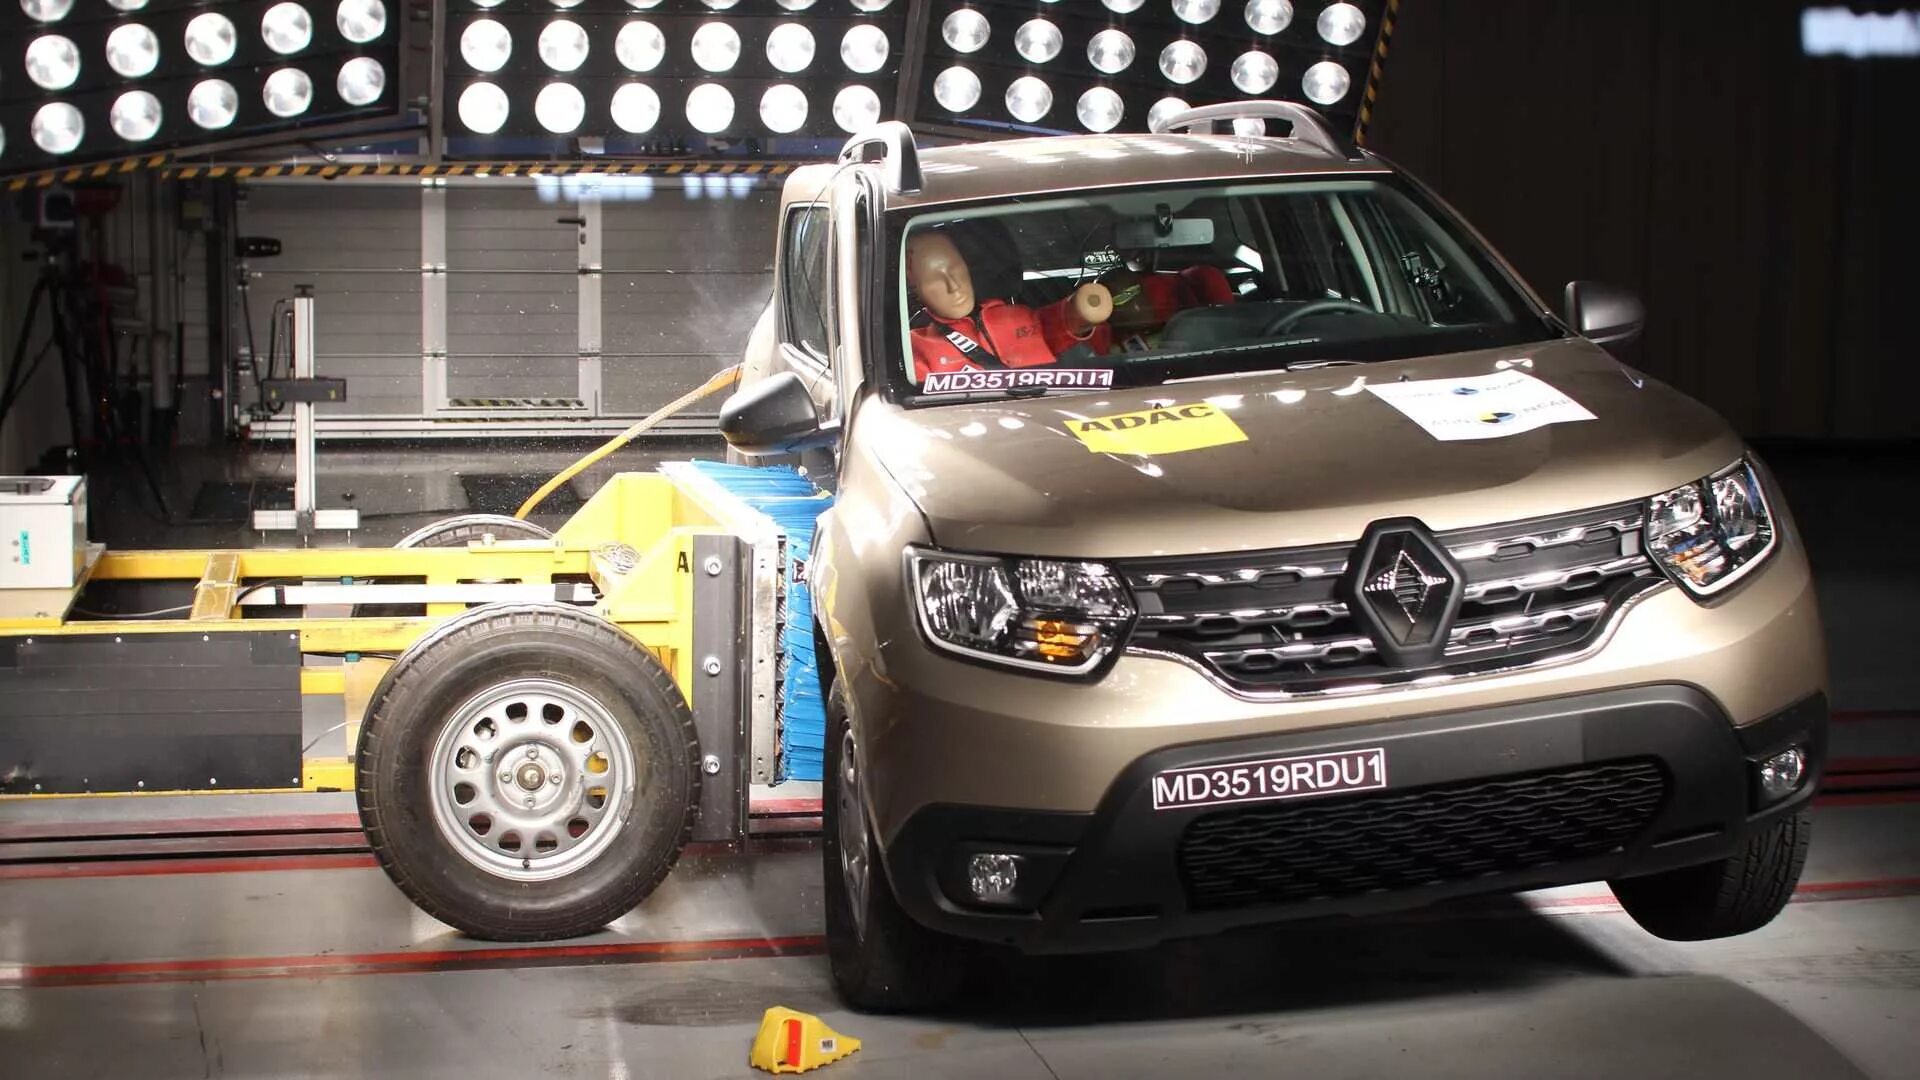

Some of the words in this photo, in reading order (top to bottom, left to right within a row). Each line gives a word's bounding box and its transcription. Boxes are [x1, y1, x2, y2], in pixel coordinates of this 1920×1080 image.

[927, 372, 1109, 391] MD3519RDU1
[1080, 406, 1213, 431] ADAC
[1155, 754, 1381, 804] MD3519RDU1
